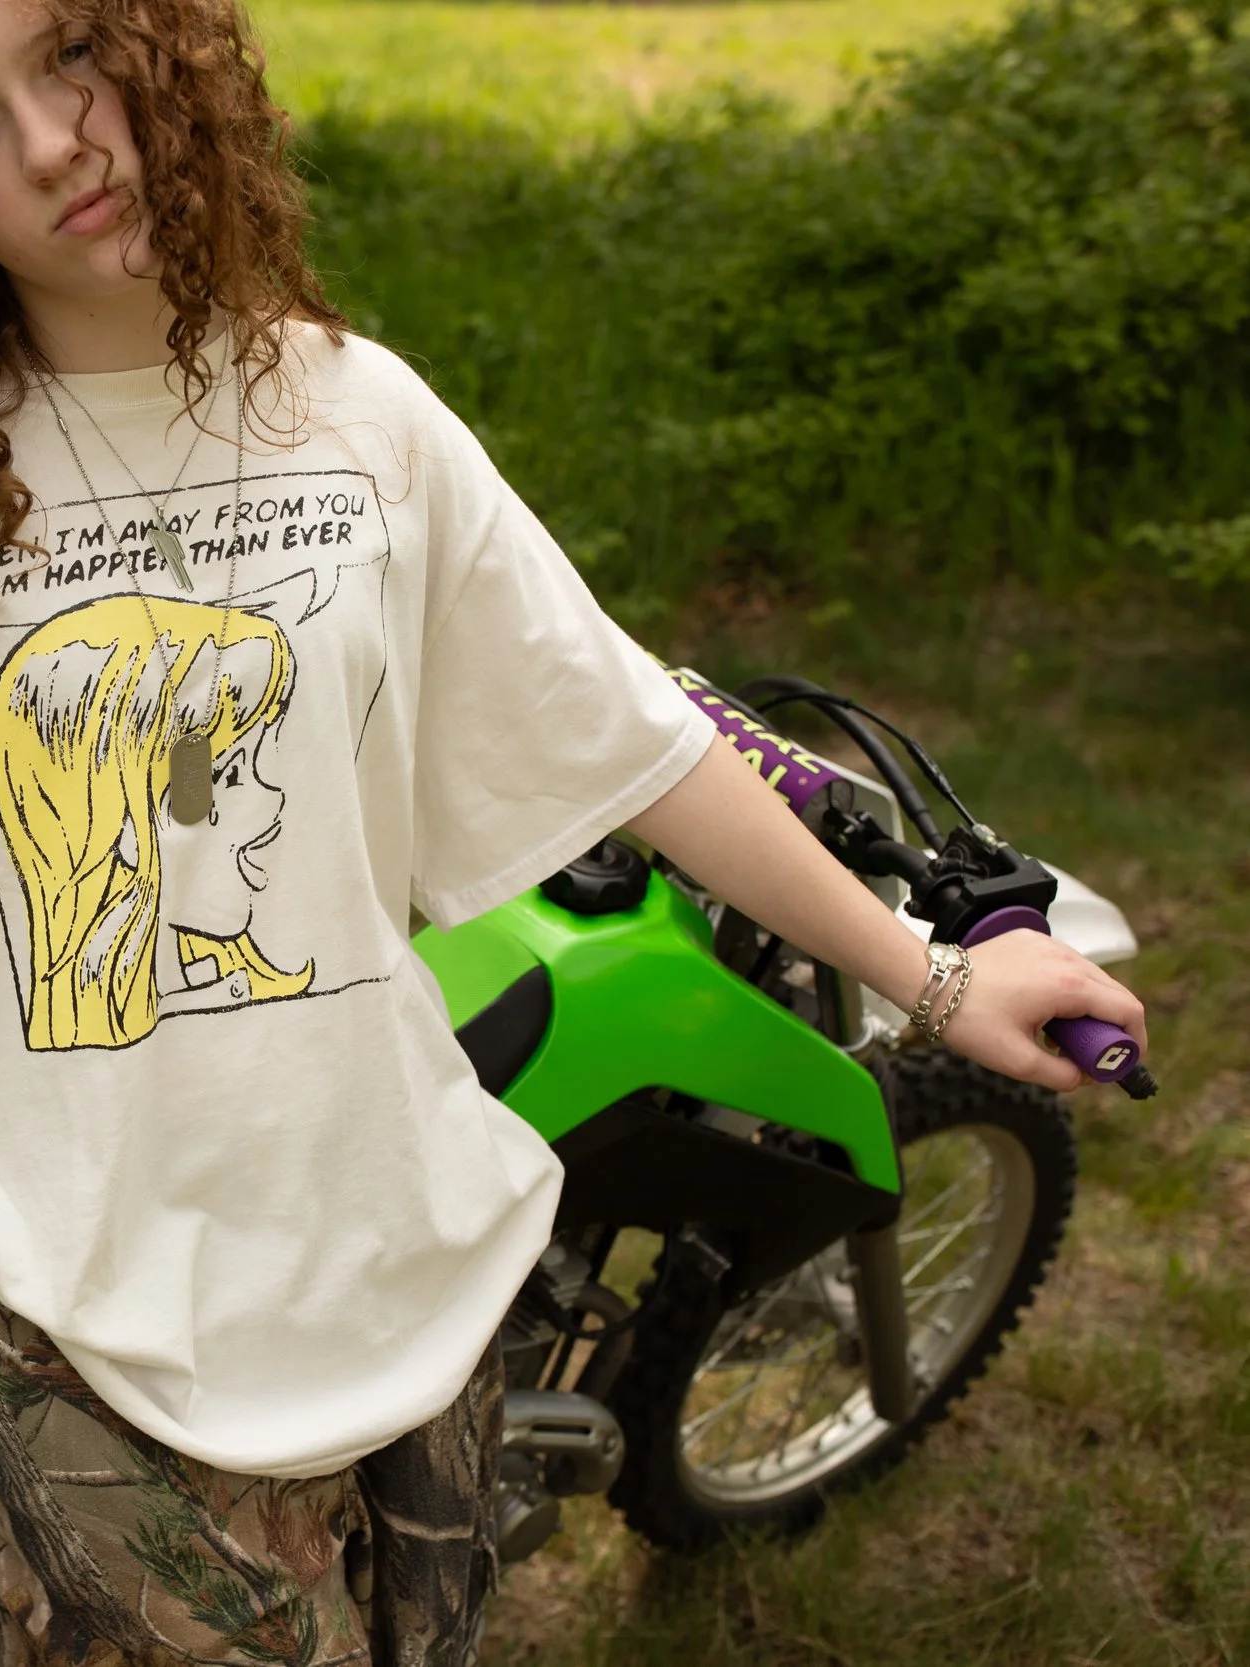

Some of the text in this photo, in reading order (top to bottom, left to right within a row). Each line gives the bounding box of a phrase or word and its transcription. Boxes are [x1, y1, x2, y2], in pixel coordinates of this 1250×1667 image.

[215, 496, 304, 529] FROM
[316, 493, 365, 516] YOU
[189, 530, 270, 565] THAN
[282, 521, 352, 550] EVER
